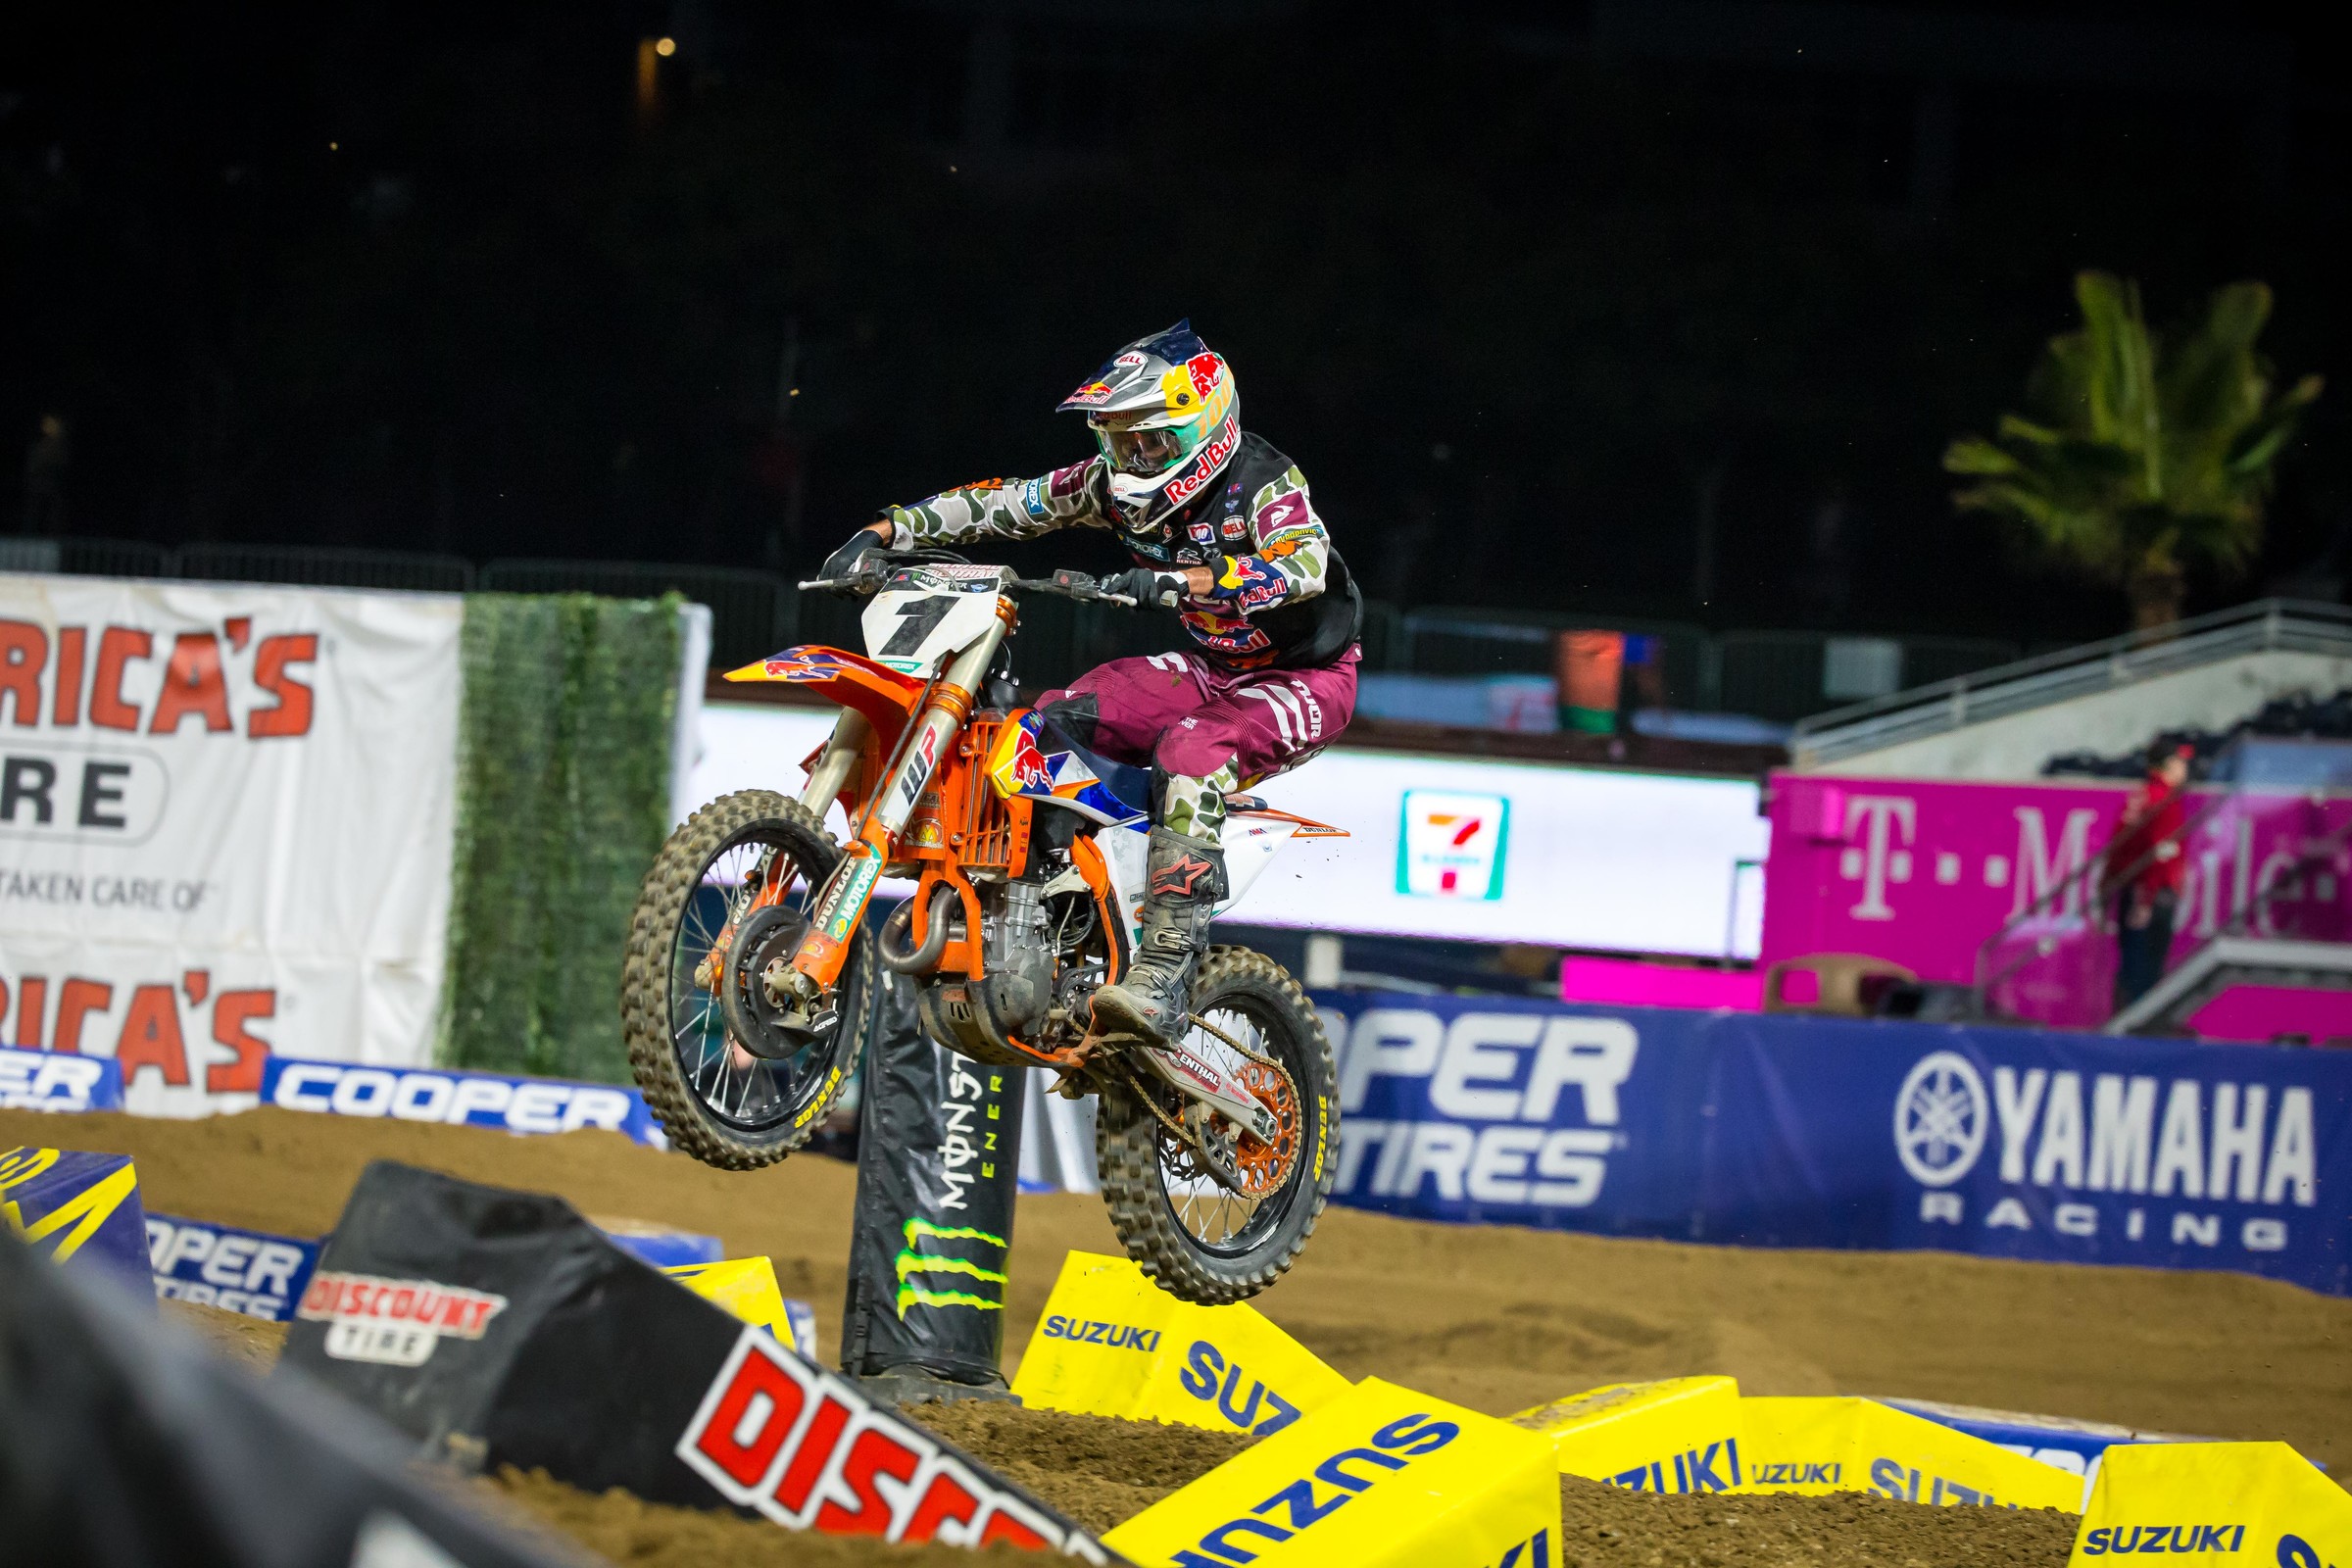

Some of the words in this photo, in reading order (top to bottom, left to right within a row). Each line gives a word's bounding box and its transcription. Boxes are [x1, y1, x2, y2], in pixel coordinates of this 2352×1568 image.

[1118, 355, 1141, 365] BELL
[1164, 453, 1213, 505] Red
[1205, 414, 1237, 468] Bull
[877, 595, 962, 658] 1
[814, 857, 858, 931] DUNLOP
[839, 850, 882, 921] MOTOREX
[0, 966, 276, 1094] ICA'S
[274, 1063, 630, 1134] COOPER
[795, 1065, 842, 1128] DUNLOP
[1176, 1047, 1219, 1088] ENTHAL
[1313, 1094, 1328, 1183] DUNLOP
[1333, 1119, 1609, 1208] TIRES
[1992, 1066, 2315, 1208] YAMAHA
[1920, 1192, 2289, 1251] RACING
[299, 1277, 495, 1335] DISCOUNT
[1043, 1314, 1161, 1353] SUZUKI
[342, 1325, 422, 1356] TIRE
[2082, 1525, 2246, 1556] SUZUKI
